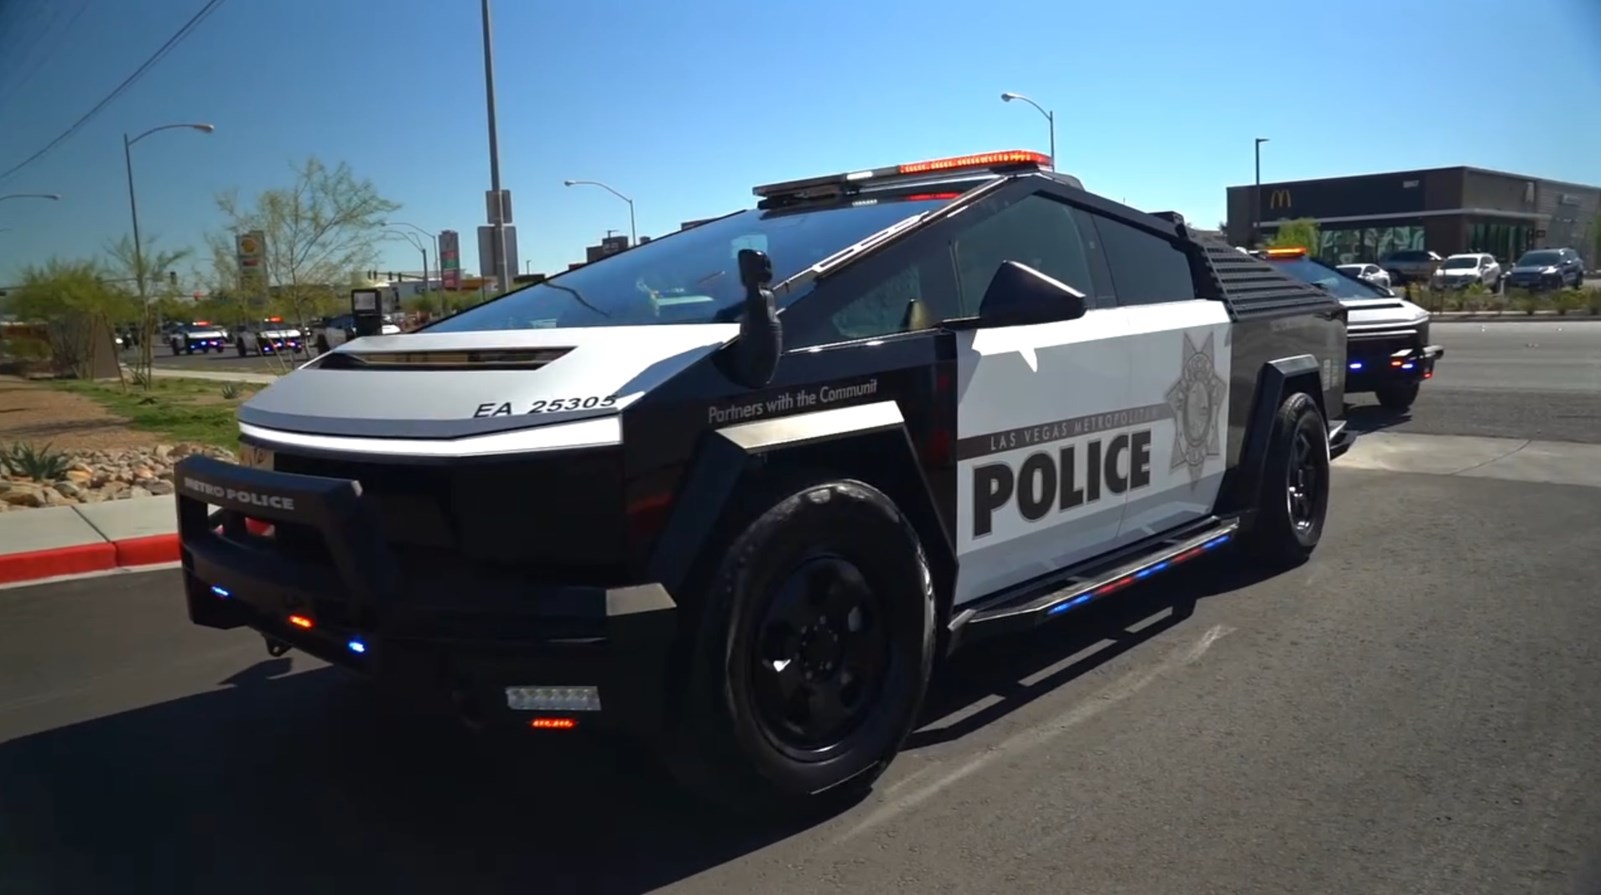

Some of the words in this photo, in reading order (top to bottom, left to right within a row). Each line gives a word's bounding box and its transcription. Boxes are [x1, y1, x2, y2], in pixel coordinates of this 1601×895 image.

[473, 402, 513, 419] EA
[528, 394, 616, 412] 25305
[708, 404, 764, 424] Partners
[767, 392, 793, 412] with
[797, 390, 817, 408] the
[990, 435, 1016, 451] LAS
[1024, 426, 1068, 442] VEGAS
[184, 477, 225, 498] METRO
[227, 487, 295, 509] POLICE
[972, 429, 1152, 540] POLICE
